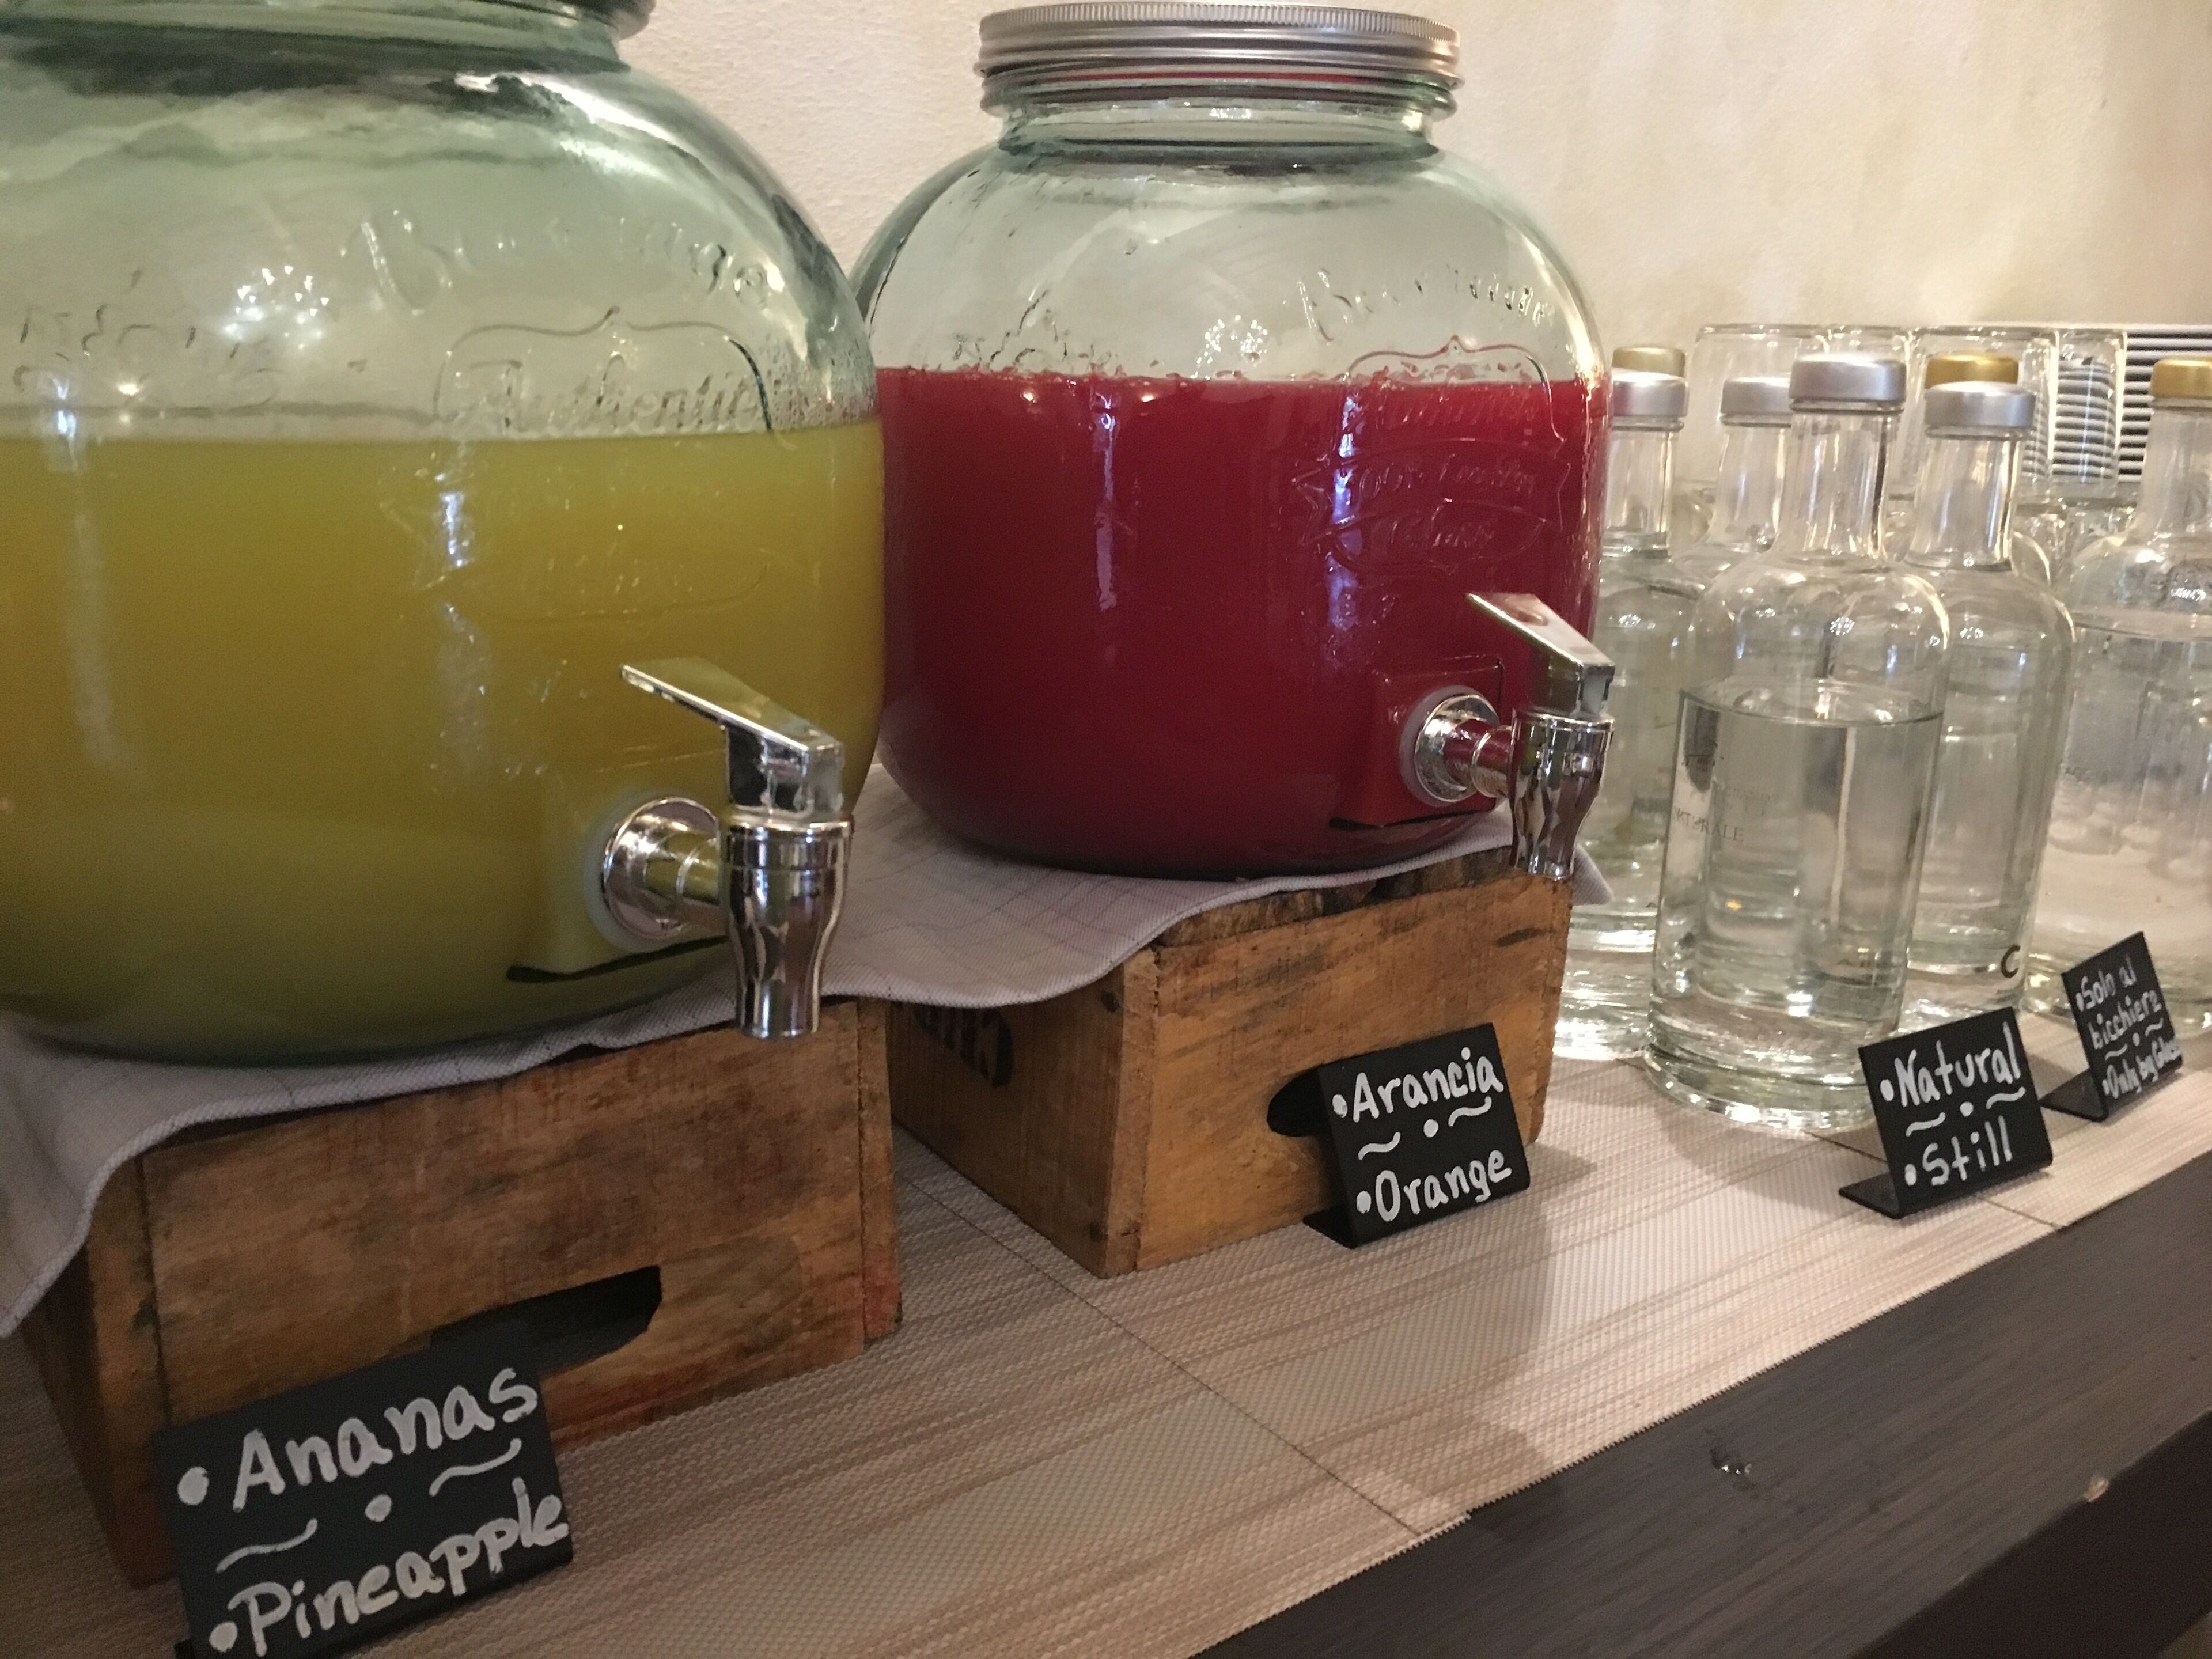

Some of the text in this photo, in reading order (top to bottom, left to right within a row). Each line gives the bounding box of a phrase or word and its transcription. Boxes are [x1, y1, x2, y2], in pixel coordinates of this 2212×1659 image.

[2081, 954, 2137, 1010] Solo al
[1353, 1046, 1504, 1123] Arancia
[1893, 1021, 2021, 1107] Natural
[1375, 1149, 1512, 1222] Orange
[1922, 1115, 2013, 1186] Still
[232, 1367, 538, 1513] Ananas
[227, 1476, 569, 1657] Pineapple
